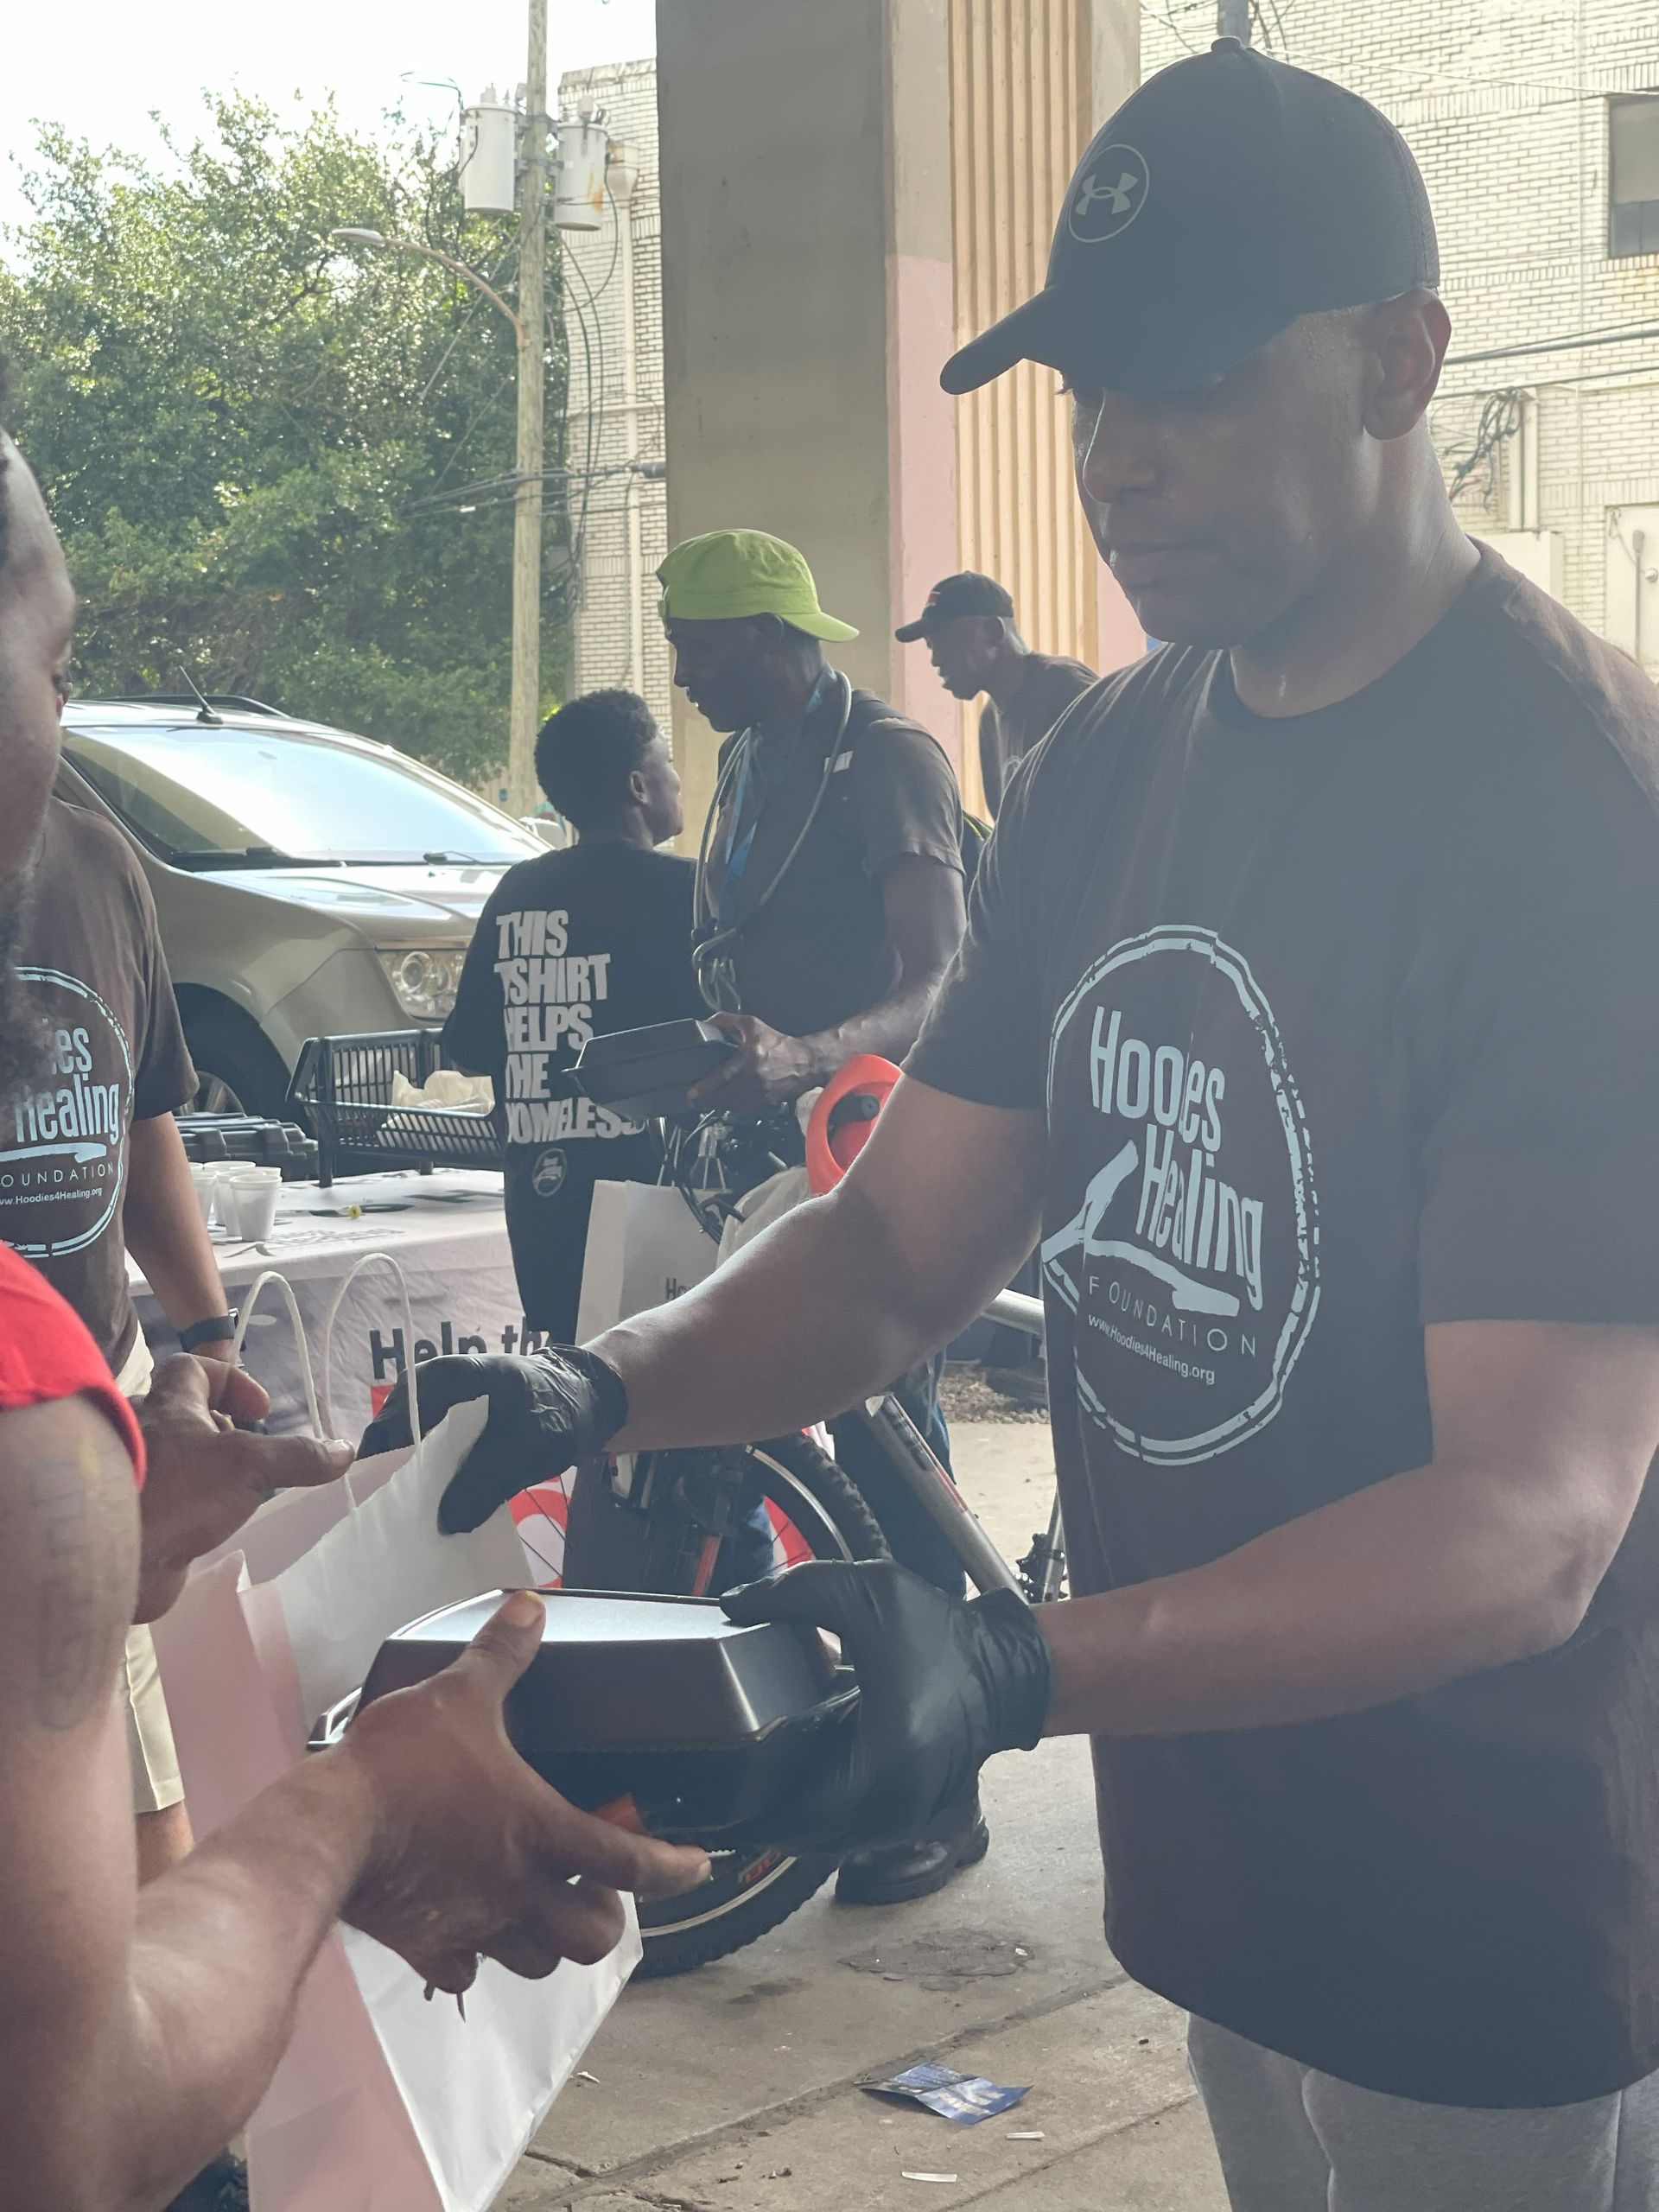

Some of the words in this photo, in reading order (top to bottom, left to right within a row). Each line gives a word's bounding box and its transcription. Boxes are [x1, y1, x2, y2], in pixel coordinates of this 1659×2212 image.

[496, 910, 569, 959] THIS
[493, 954, 611, 1006] TSHIRT
[0, 1163, 114, 1187] OUNDATION
[1135, 1123, 1264, 1311] Healing
[1089, 1275, 1256, 1357] FOUNDATION
[1088, 1313, 1216, 1385] www.Hoodies4Healing.org
